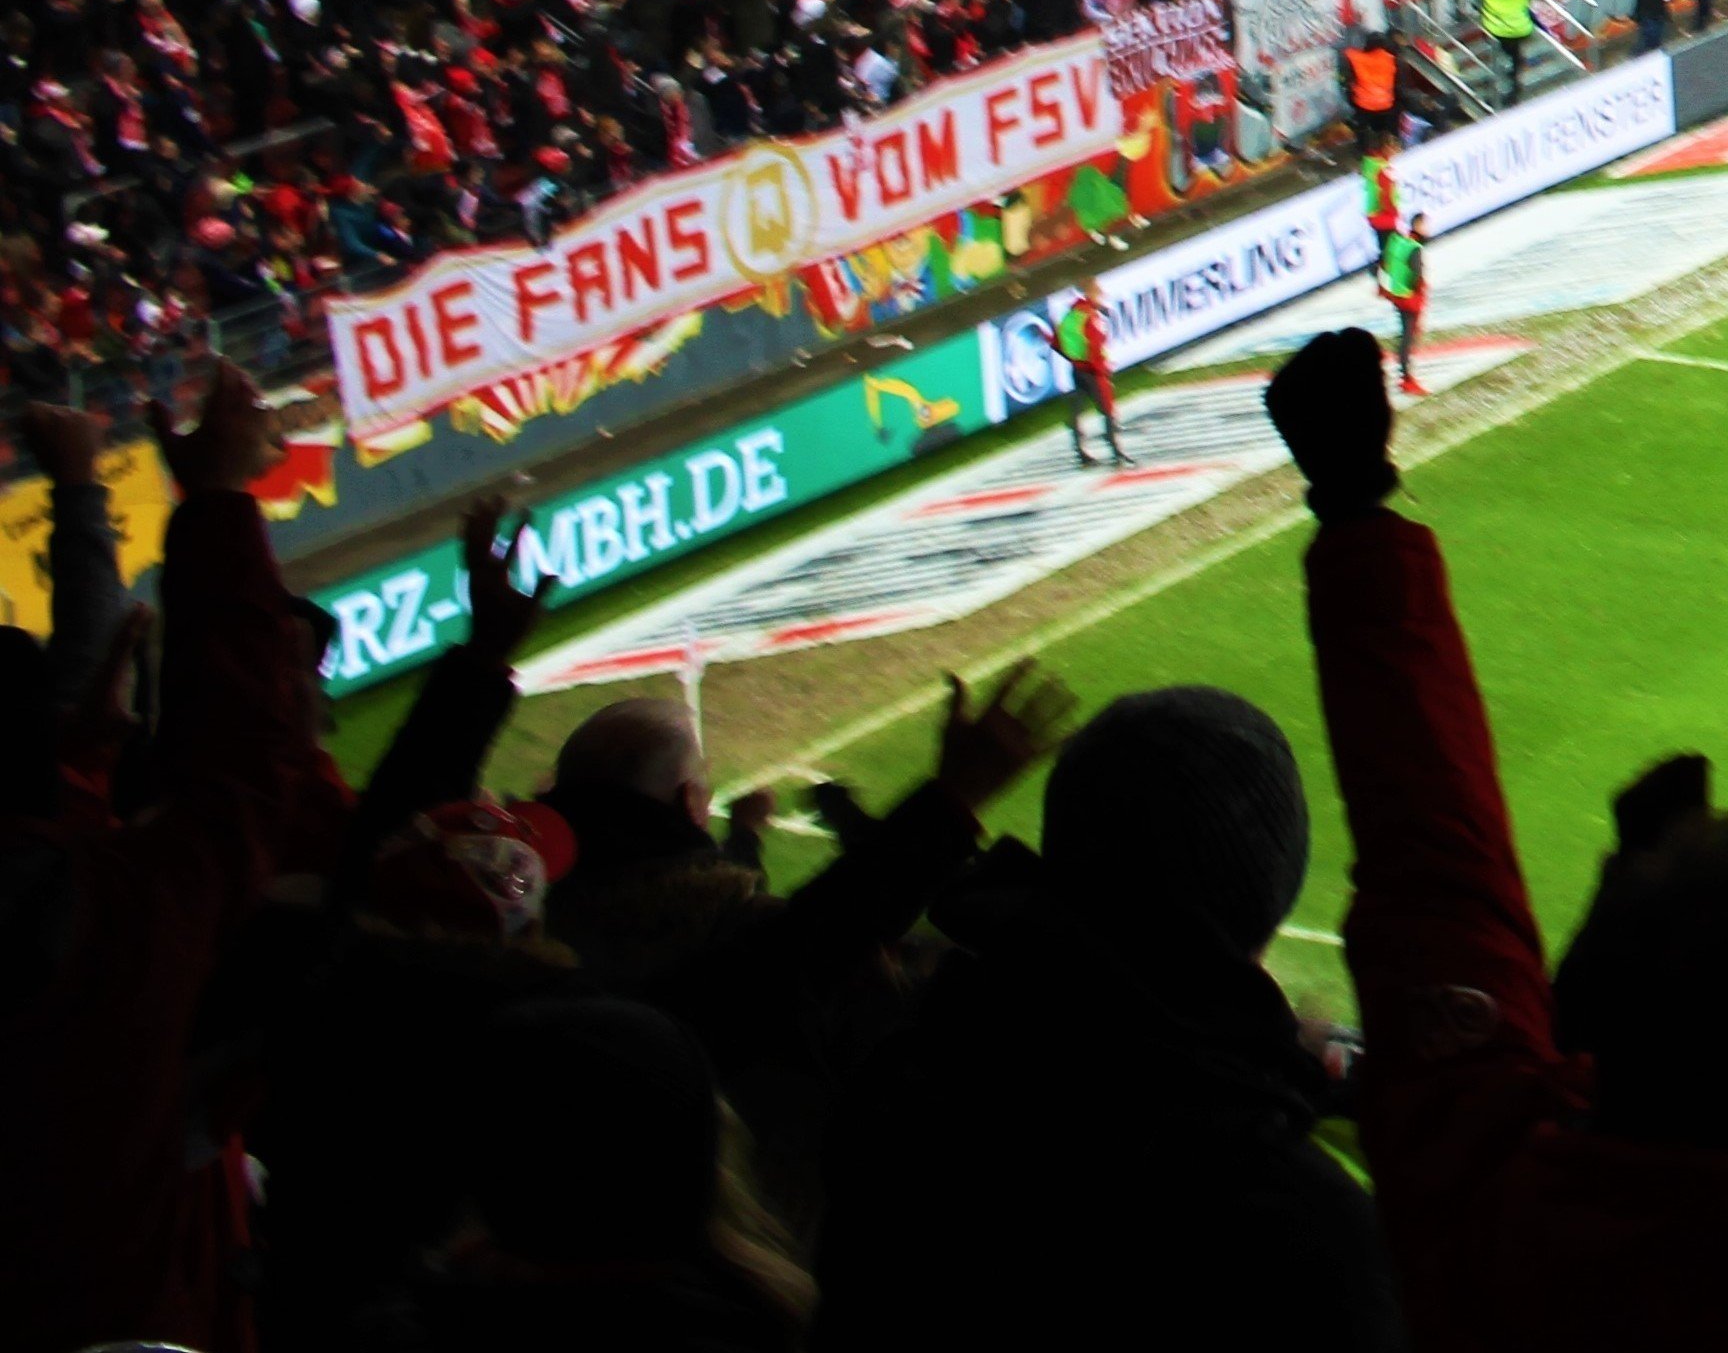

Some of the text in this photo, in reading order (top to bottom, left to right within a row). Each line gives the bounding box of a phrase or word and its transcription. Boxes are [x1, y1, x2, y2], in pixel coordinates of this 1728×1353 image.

[352, 280, 483, 400] DIE
[512, 201, 710, 345] FANS
[826, 106, 961, 223] VOM
[984, 58, 1104, 165] FSV
